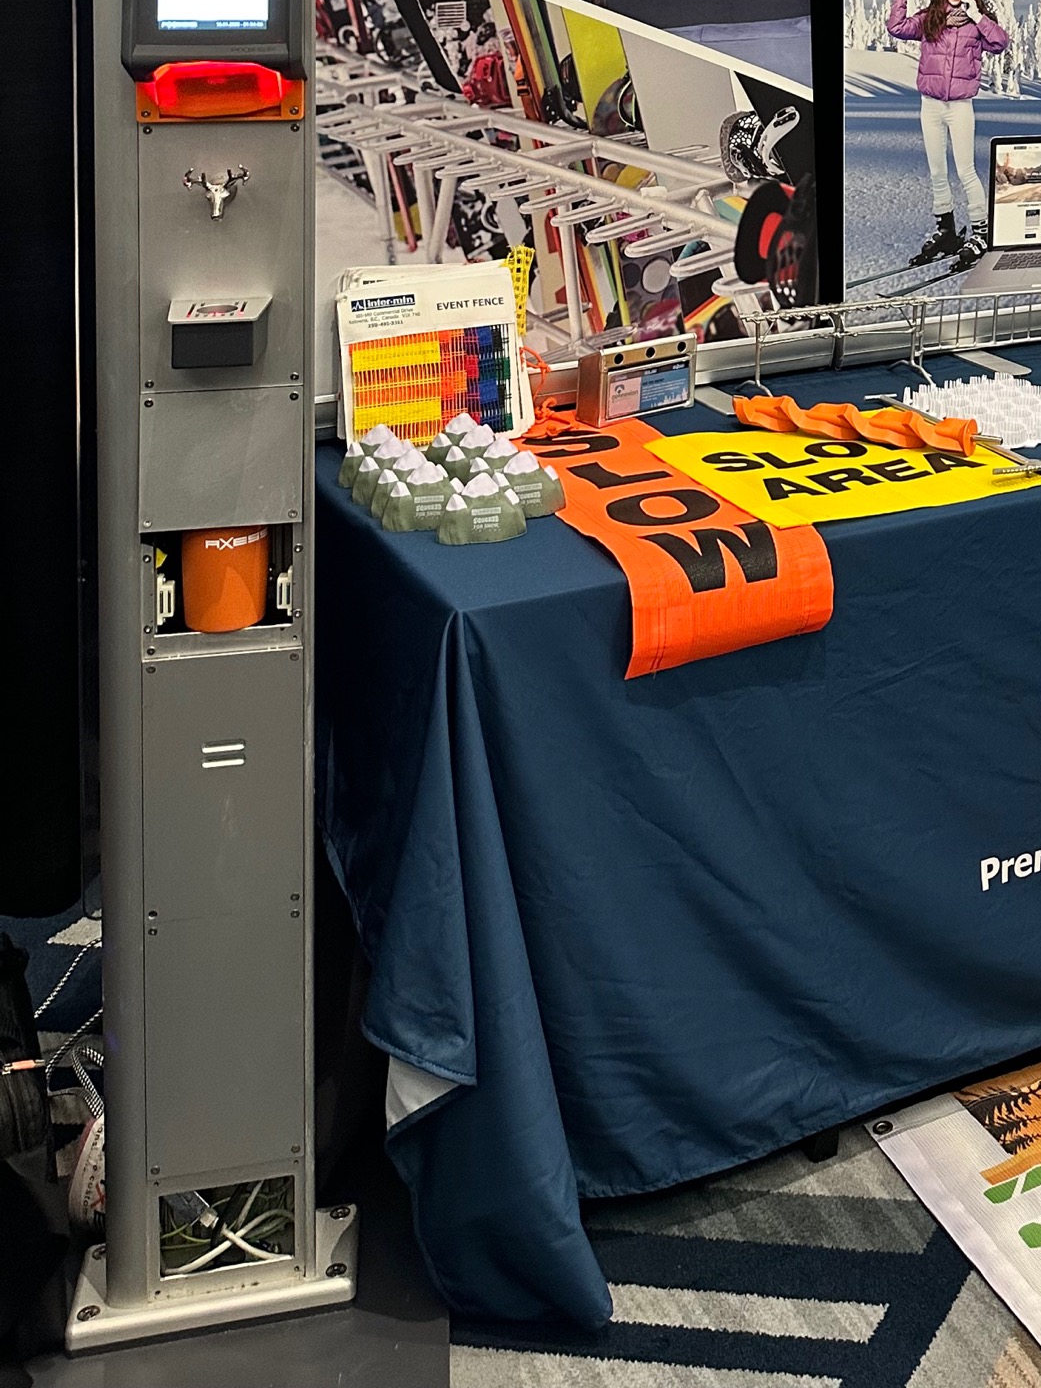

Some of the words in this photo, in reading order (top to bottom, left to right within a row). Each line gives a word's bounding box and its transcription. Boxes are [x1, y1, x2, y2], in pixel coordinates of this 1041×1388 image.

[437, 300, 469, 310] EVENT
[473, 297, 504, 307] FENCE
[702, 441, 904, 474] SLO
[763, 453, 988, 501] AREA
[205, 527, 268, 550] AXESS
